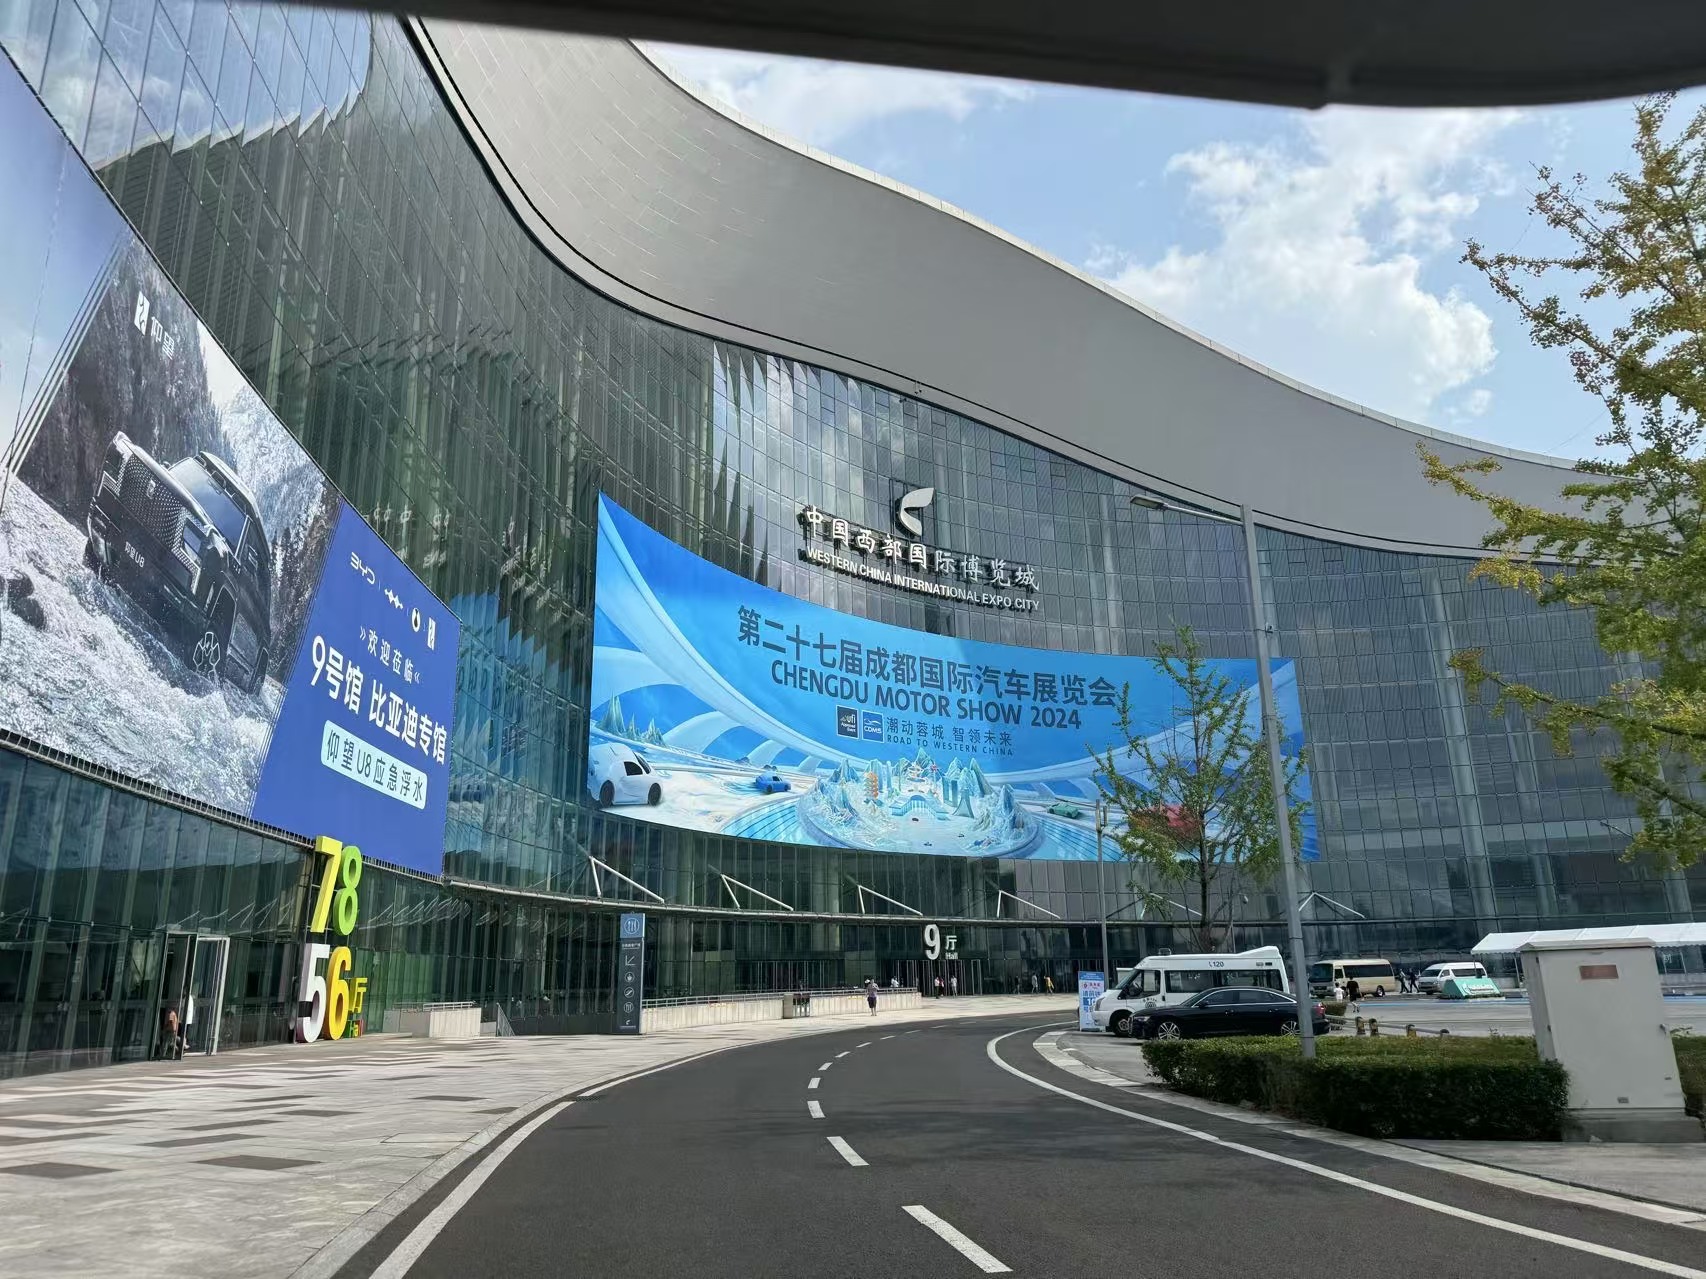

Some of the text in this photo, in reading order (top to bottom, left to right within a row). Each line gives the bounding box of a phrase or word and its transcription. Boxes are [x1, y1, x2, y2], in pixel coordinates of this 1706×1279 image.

[350, 551, 376, 585] BYD
[806, 504, 1039, 591] 中国西部国际博览城
[807, 546, 1040, 610] WESTERN CHINA INTERNATIONAL EXPO CITY
[737, 604, 1117, 706] 第二十七届成都国际汽车展览会
[310, 635, 448, 765] 9号馆 比亚迪专馆
[771, 659, 1082, 730] CHENGDU MOTOR SHOW 2024
[886, 716, 1013, 746] 潮动蓉城 智领未来
[887, 734, 1013, 756] ROAD TO WESTERN CHINA
[310, 836, 362, 936] 78
